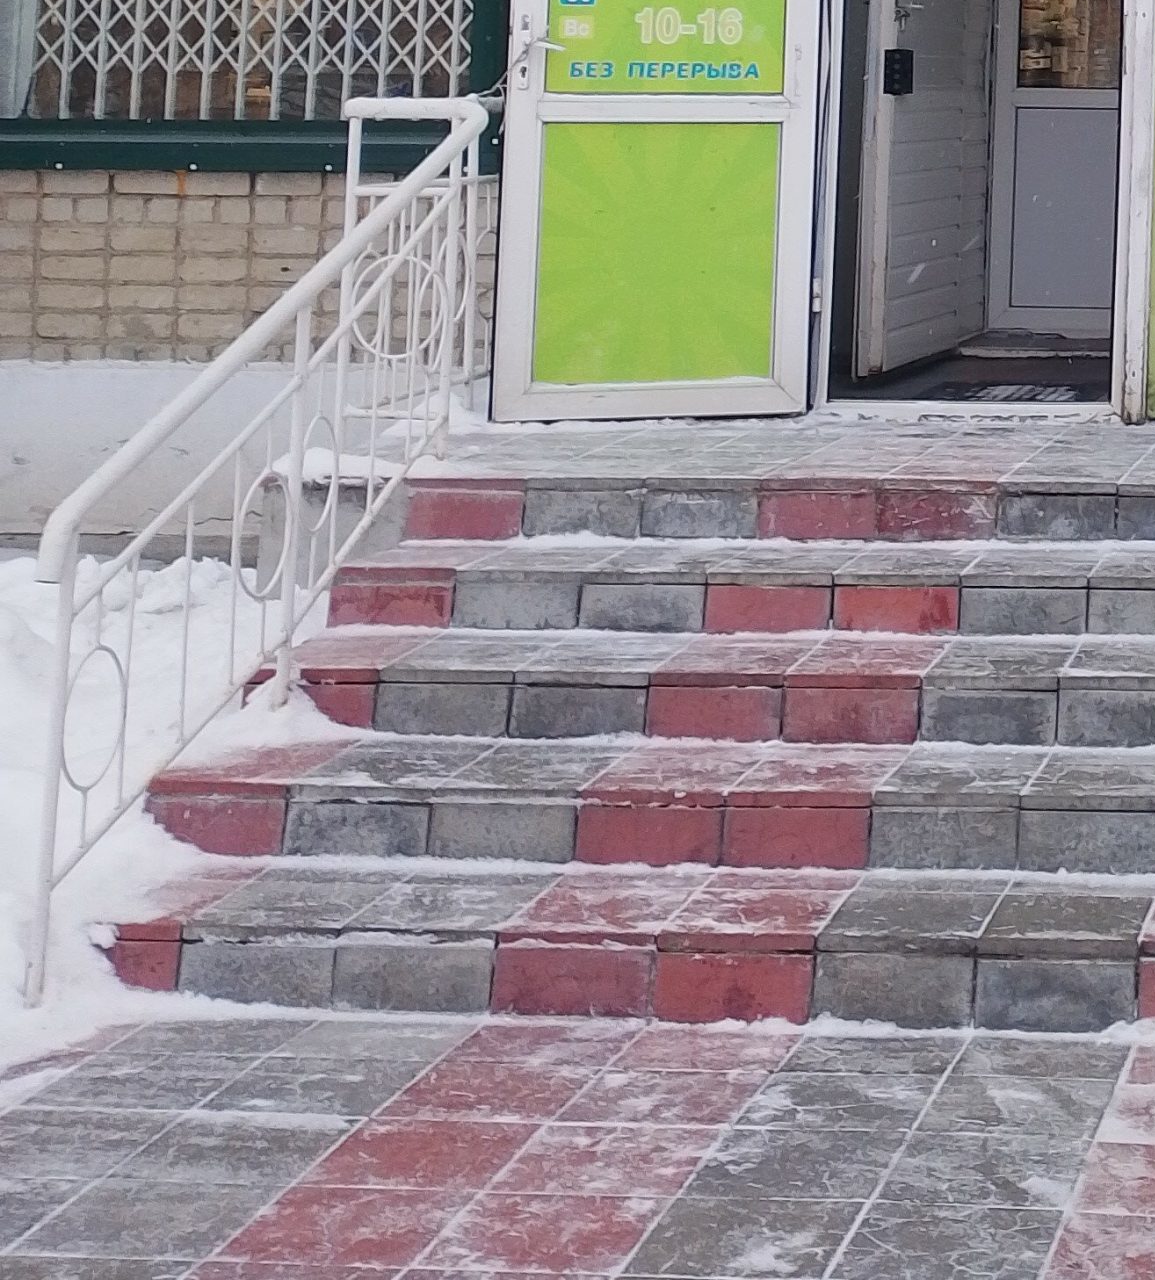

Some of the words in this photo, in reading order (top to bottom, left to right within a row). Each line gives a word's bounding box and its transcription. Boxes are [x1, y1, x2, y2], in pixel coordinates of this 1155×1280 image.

[635, 6, 743, 45] 10-16
[569, 62, 613, 79] БЕЗ
[628, 62, 759, 80] ПЕРЕРЫВА
